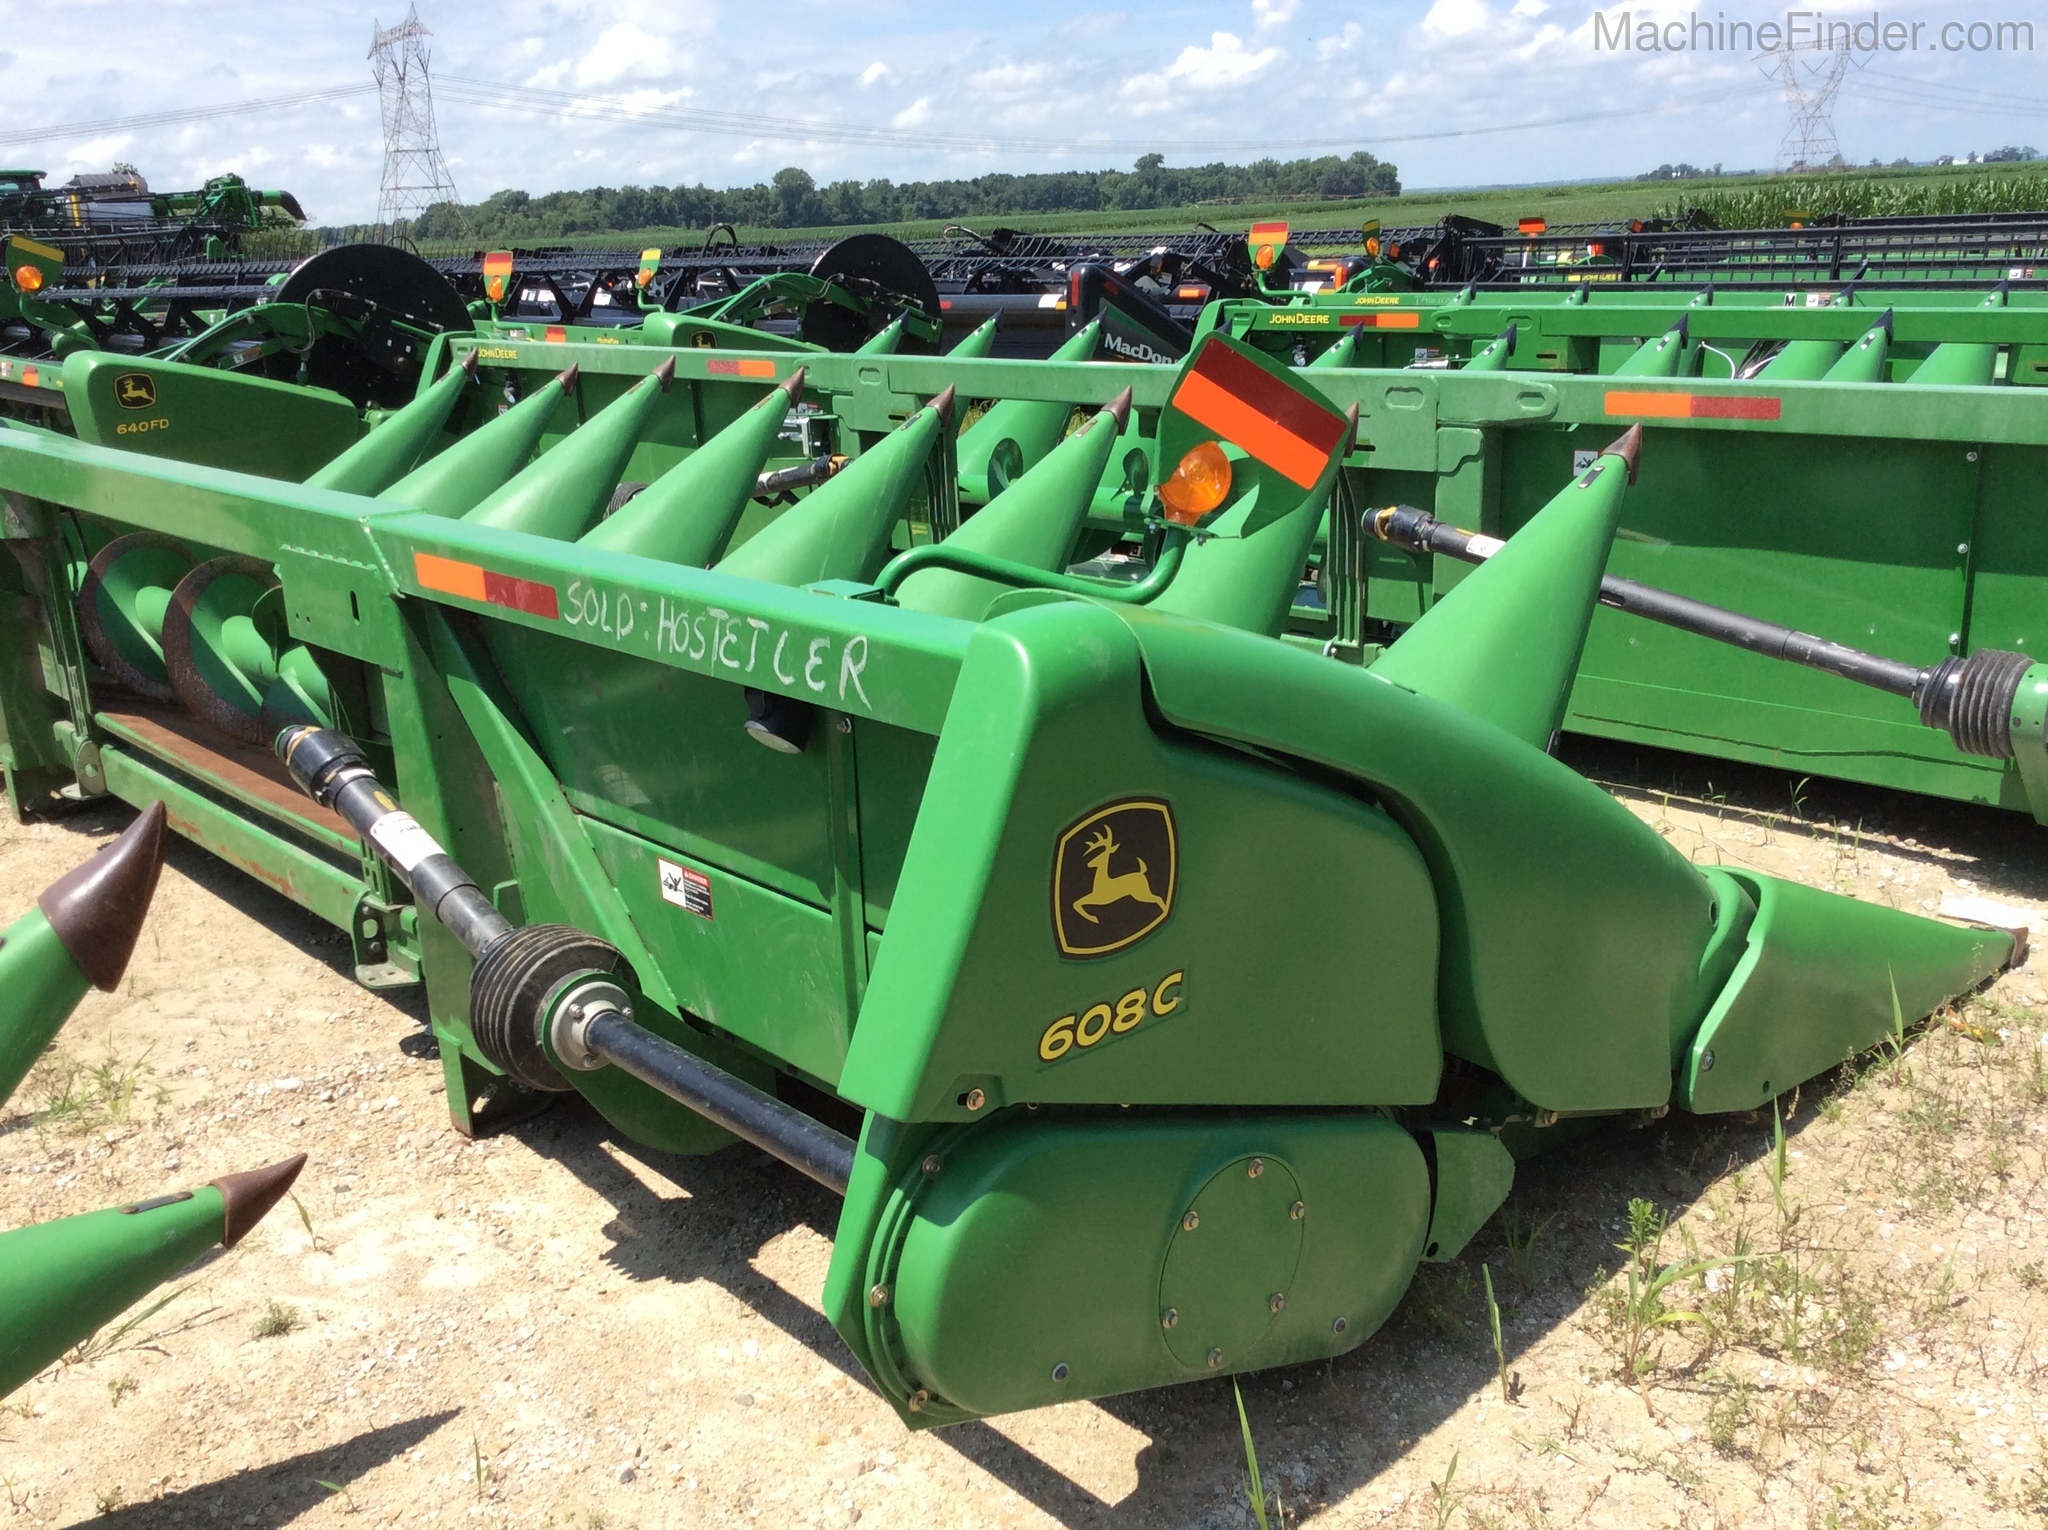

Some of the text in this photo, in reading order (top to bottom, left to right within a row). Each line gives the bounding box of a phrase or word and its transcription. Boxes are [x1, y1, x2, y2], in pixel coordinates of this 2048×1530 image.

[1354, 296, 1399, 305] JOHN DEERE
[1269, 313, 1329, 324] JOHN DEERE
[478, 346, 518, 360] JOHN DEERE
[116, 418, 169, 435] 640FD
[656, 596, 872, 711] HOSTETLER
[1038, 969, 1185, 1063] 608C
